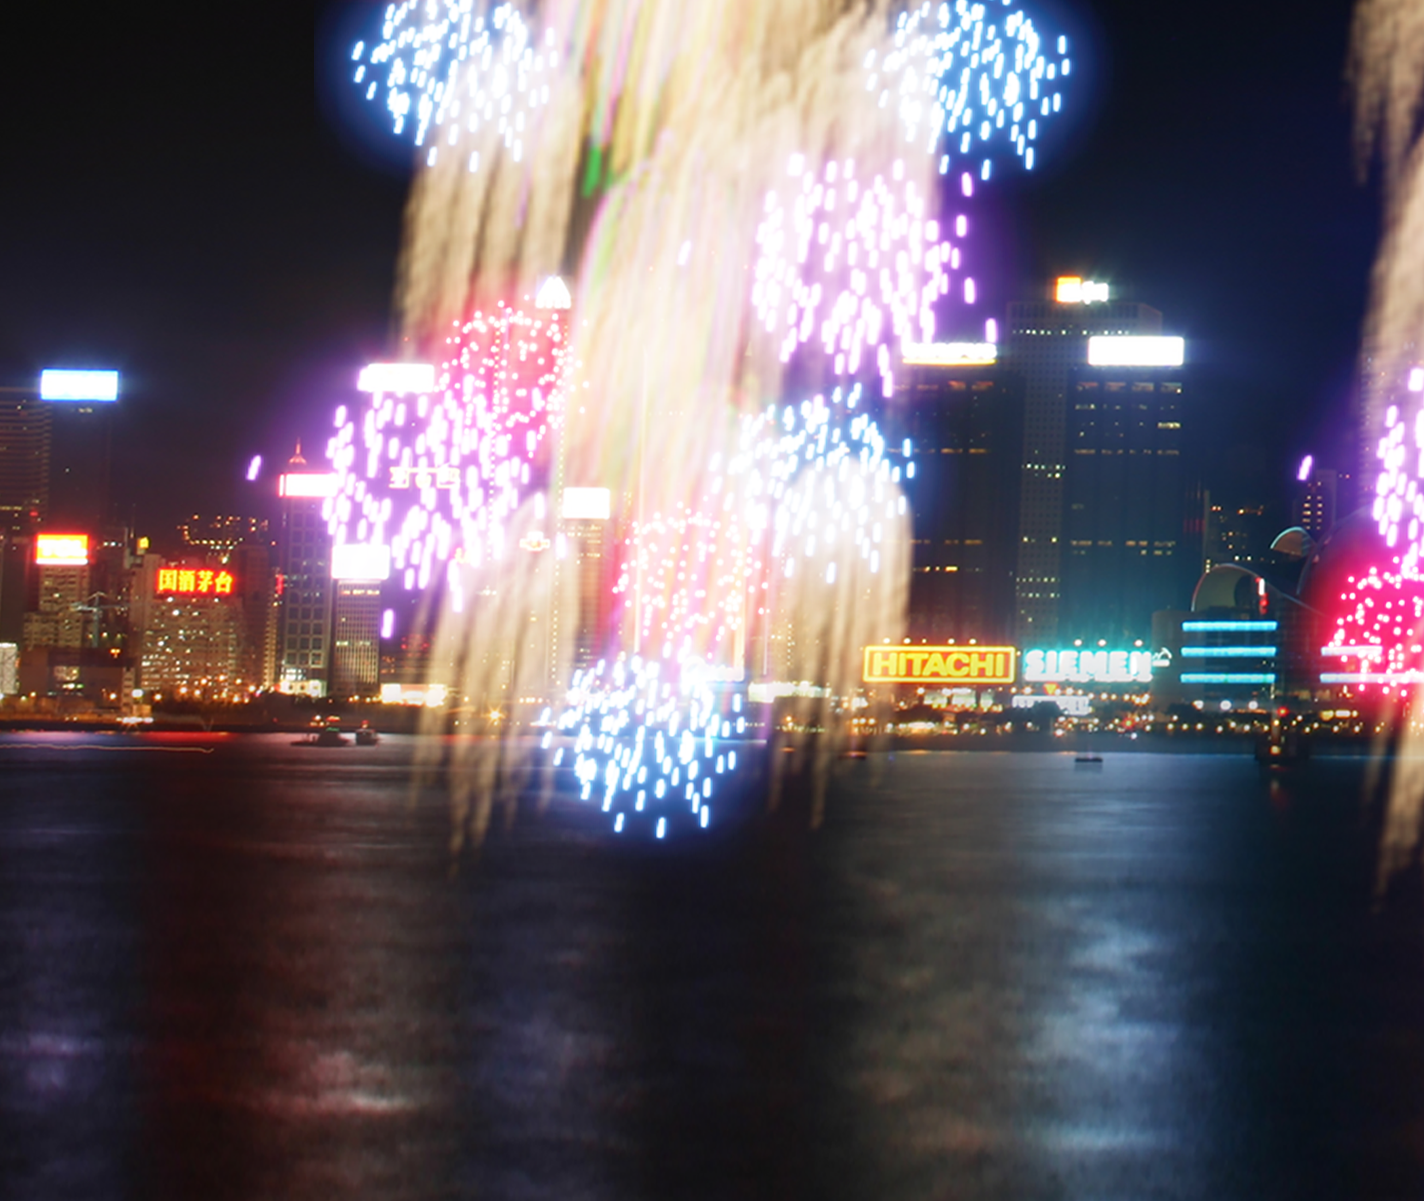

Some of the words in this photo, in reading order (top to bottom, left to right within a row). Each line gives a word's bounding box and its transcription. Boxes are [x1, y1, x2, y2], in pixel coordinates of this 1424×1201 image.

[158, 569, 233, 593] 国酒茅台
[872, 652, 1005, 677] HITACHI
